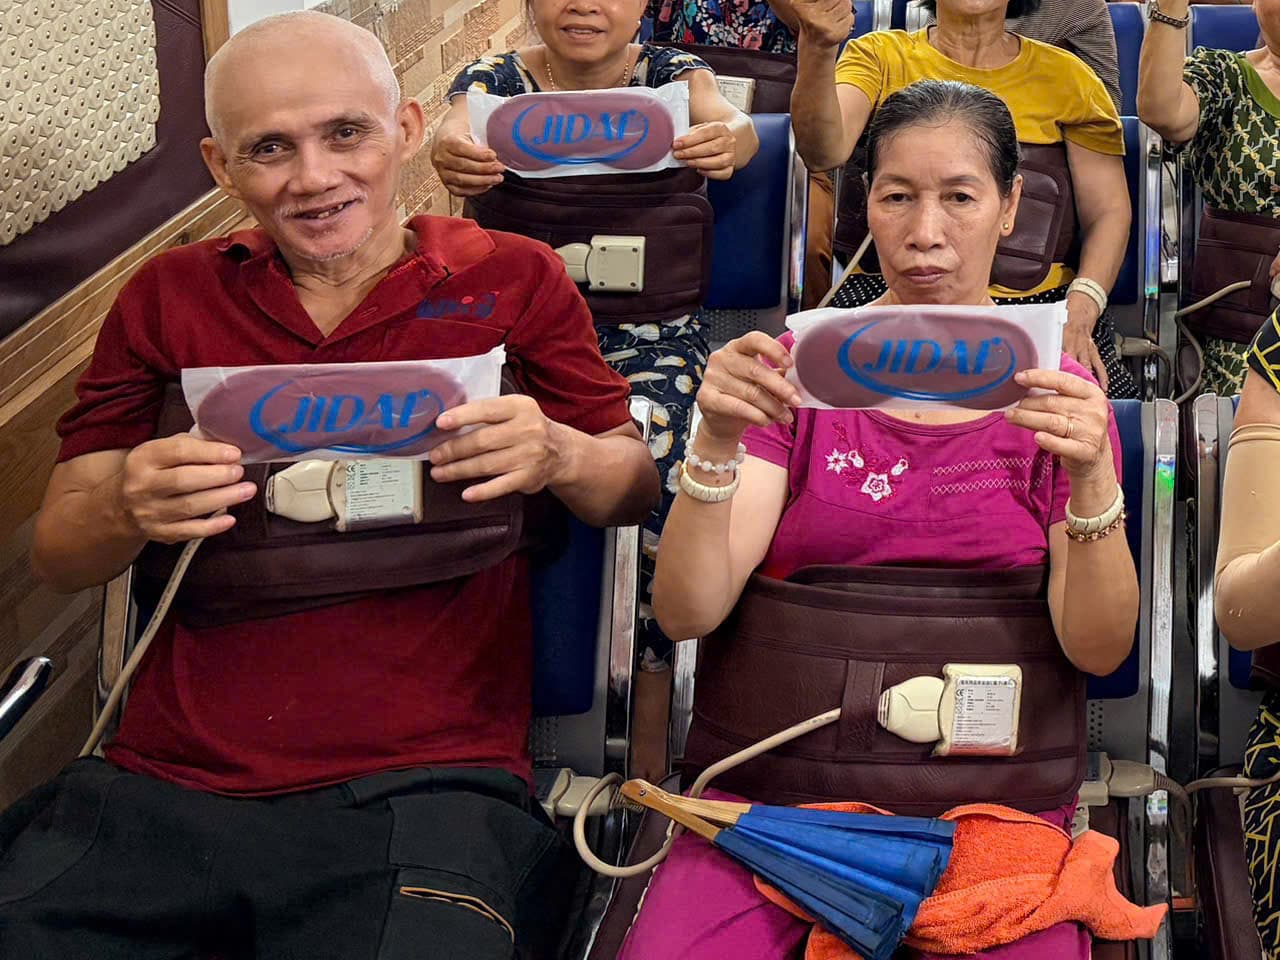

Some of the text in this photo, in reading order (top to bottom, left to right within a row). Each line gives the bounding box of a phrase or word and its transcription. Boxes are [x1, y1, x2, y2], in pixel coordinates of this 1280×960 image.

[532, 108, 638, 145] JIDAI
[861, 335, 1002, 376] JIDAI
[269, 388, 431, 434] JIDAI
